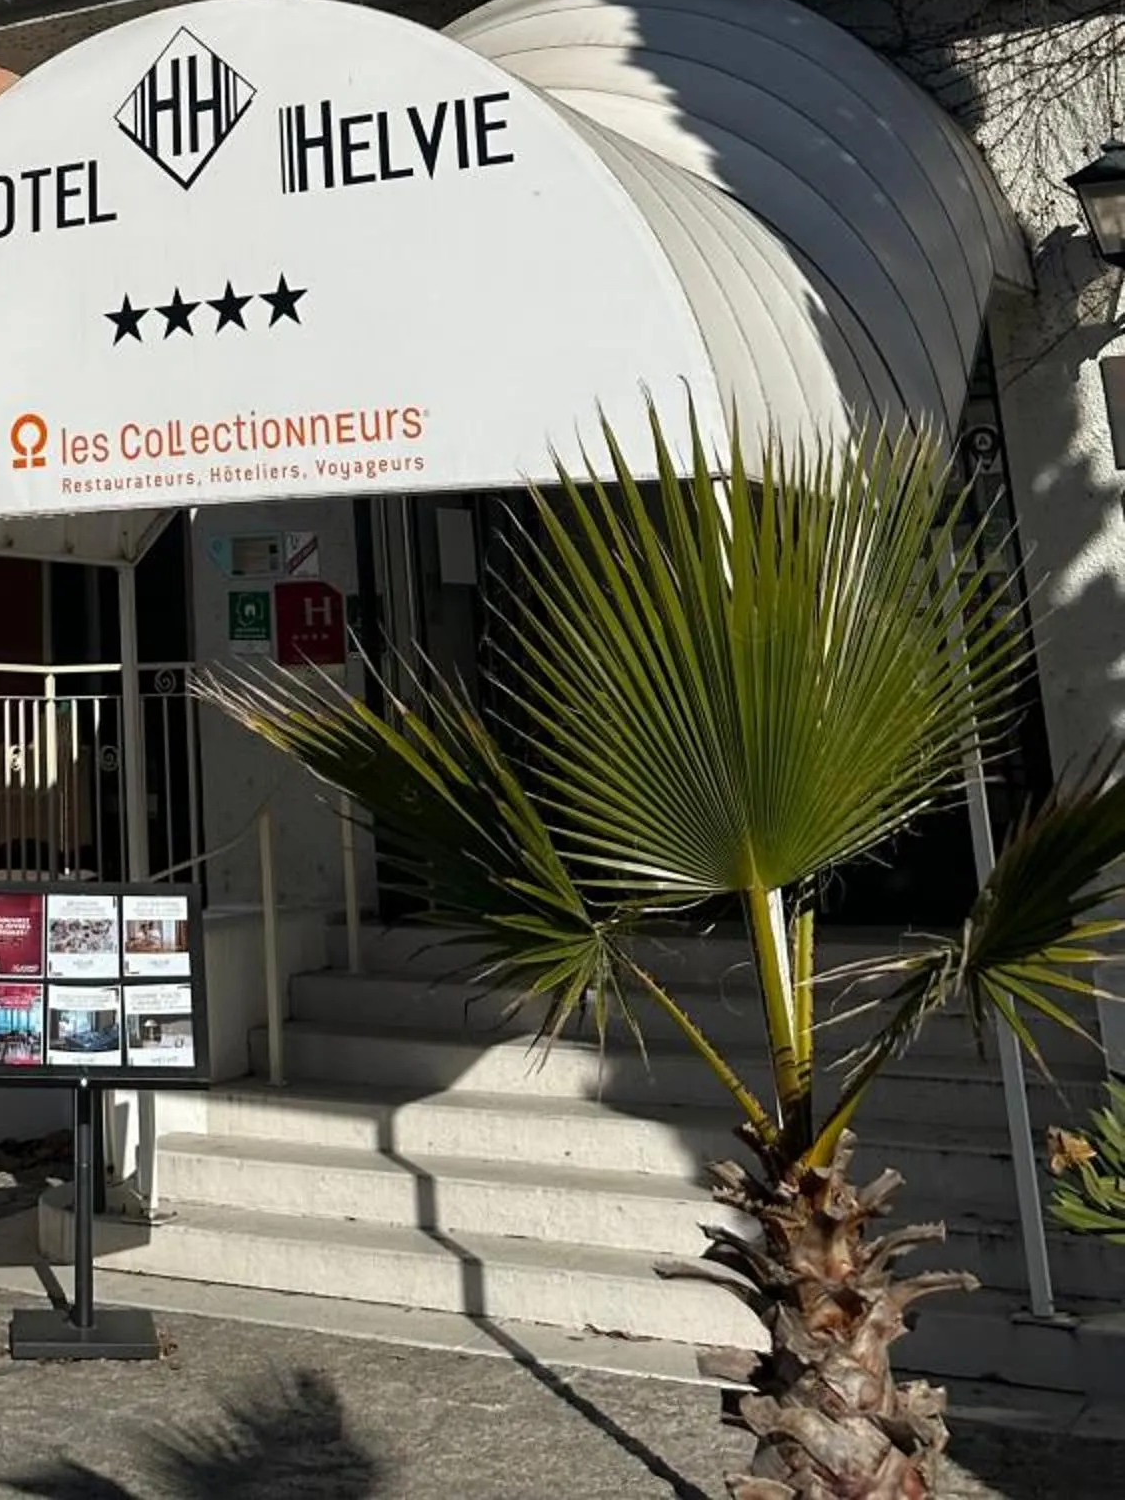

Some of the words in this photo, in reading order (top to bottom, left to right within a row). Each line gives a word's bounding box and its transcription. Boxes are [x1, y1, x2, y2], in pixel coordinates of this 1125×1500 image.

[279, 91, 514, 194] HELVIE
[61, 427, 110, 465] les
[62, 471, 203, 494] Restaurateurs,
[315, 455, 425, 481] Voyageurs
[303, 595, 332, 627] H
